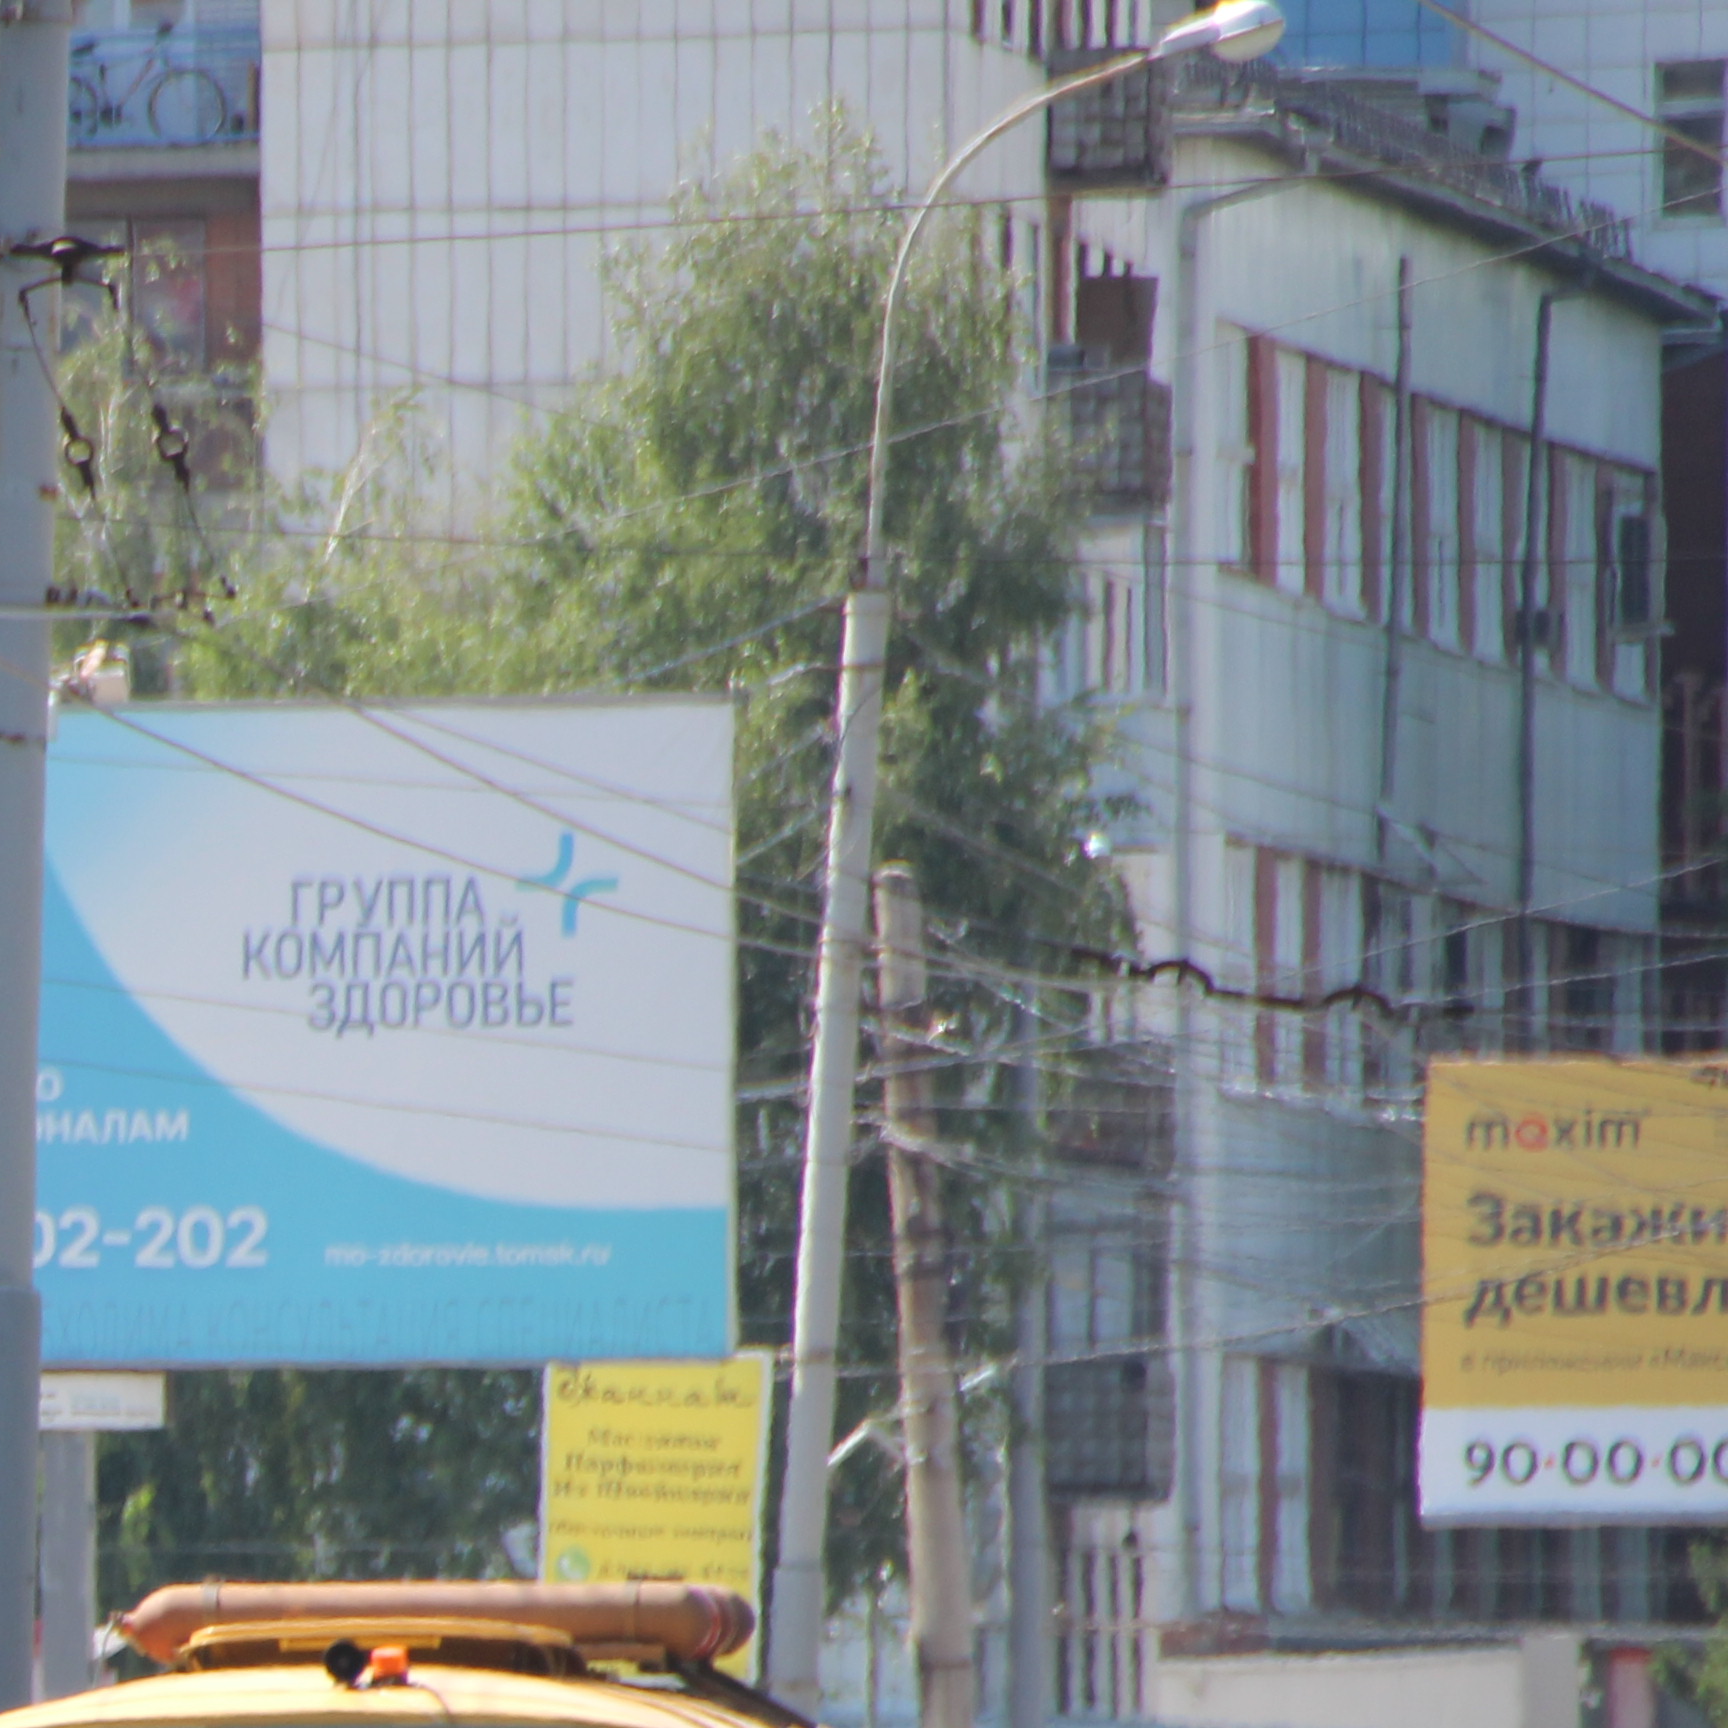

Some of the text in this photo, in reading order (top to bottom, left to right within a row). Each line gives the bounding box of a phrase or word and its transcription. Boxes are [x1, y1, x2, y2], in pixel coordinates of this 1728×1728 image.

[291, 875, 486, 928] ГРУППА
[242, 912, 524, 980] КОМПАНИЙ
[307, 978, 575, 1038] ЗДОРОВЬЕ
